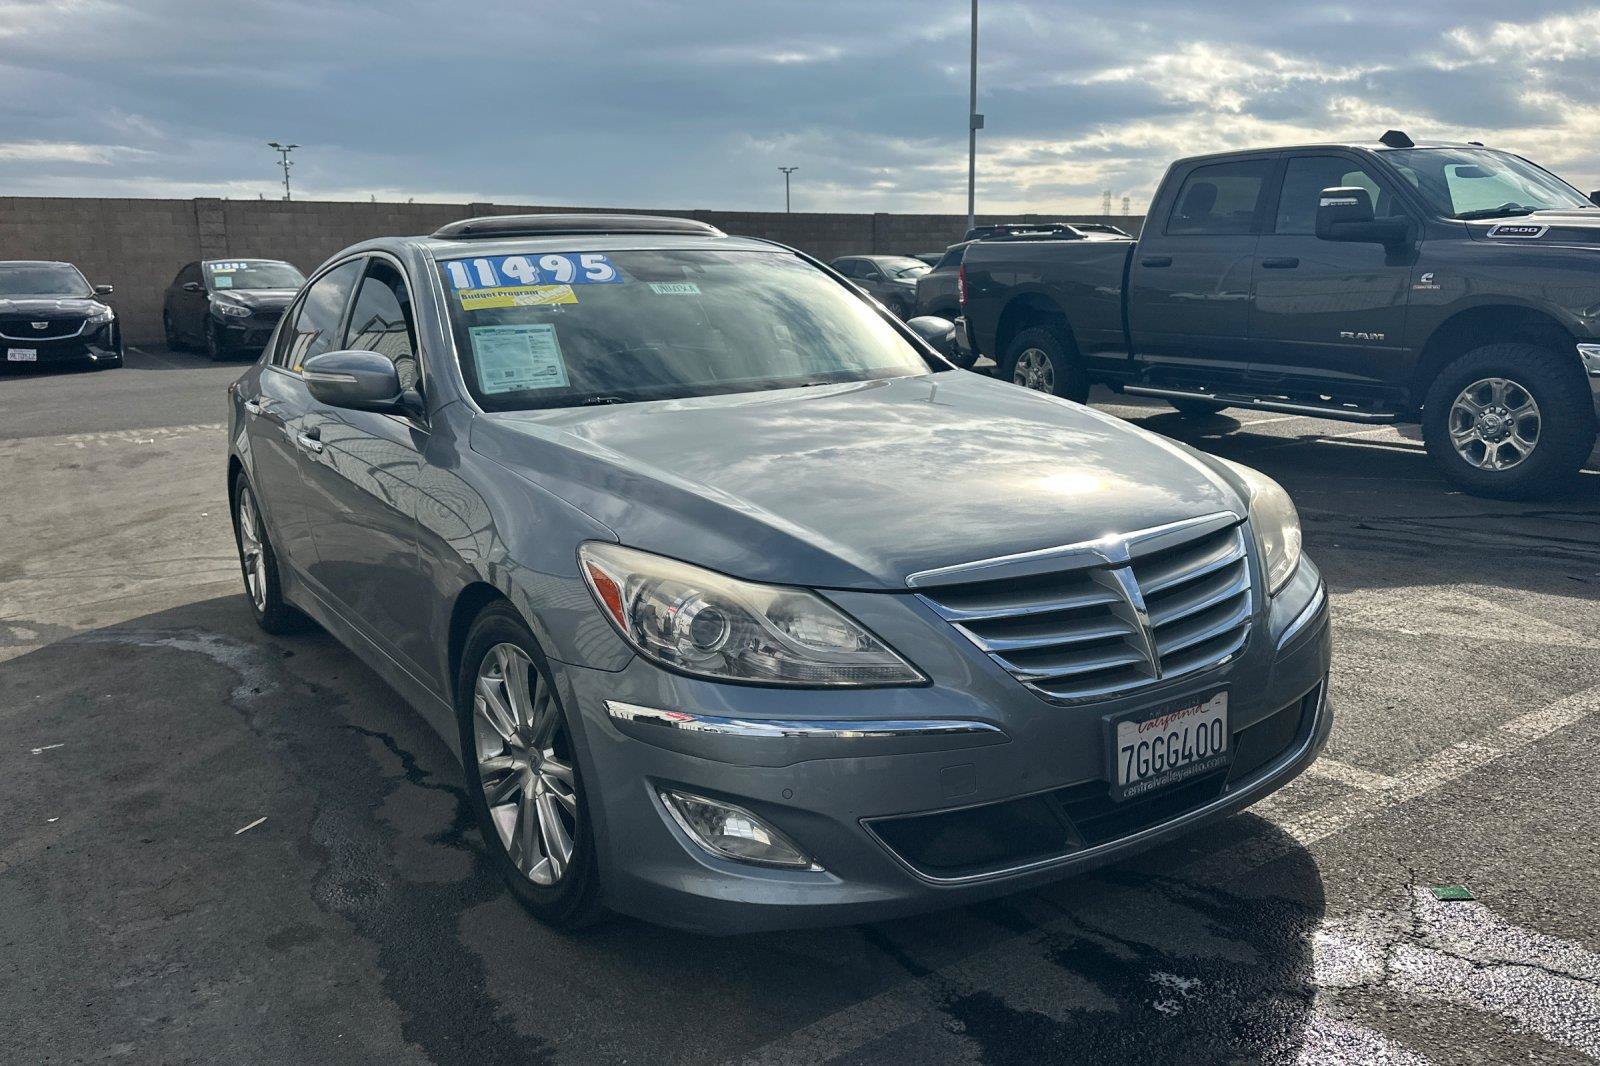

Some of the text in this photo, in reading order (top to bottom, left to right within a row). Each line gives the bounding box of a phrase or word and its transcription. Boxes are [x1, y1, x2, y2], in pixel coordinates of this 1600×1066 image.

[447, 254, 618, 289] 11495
[461, 289, 539, 300] Budget Program
[1340, 331, 1385, 341] RAM
[1138, 703, 1211, 734] California
[1121, 717, 1223, 784] 7GGG400
